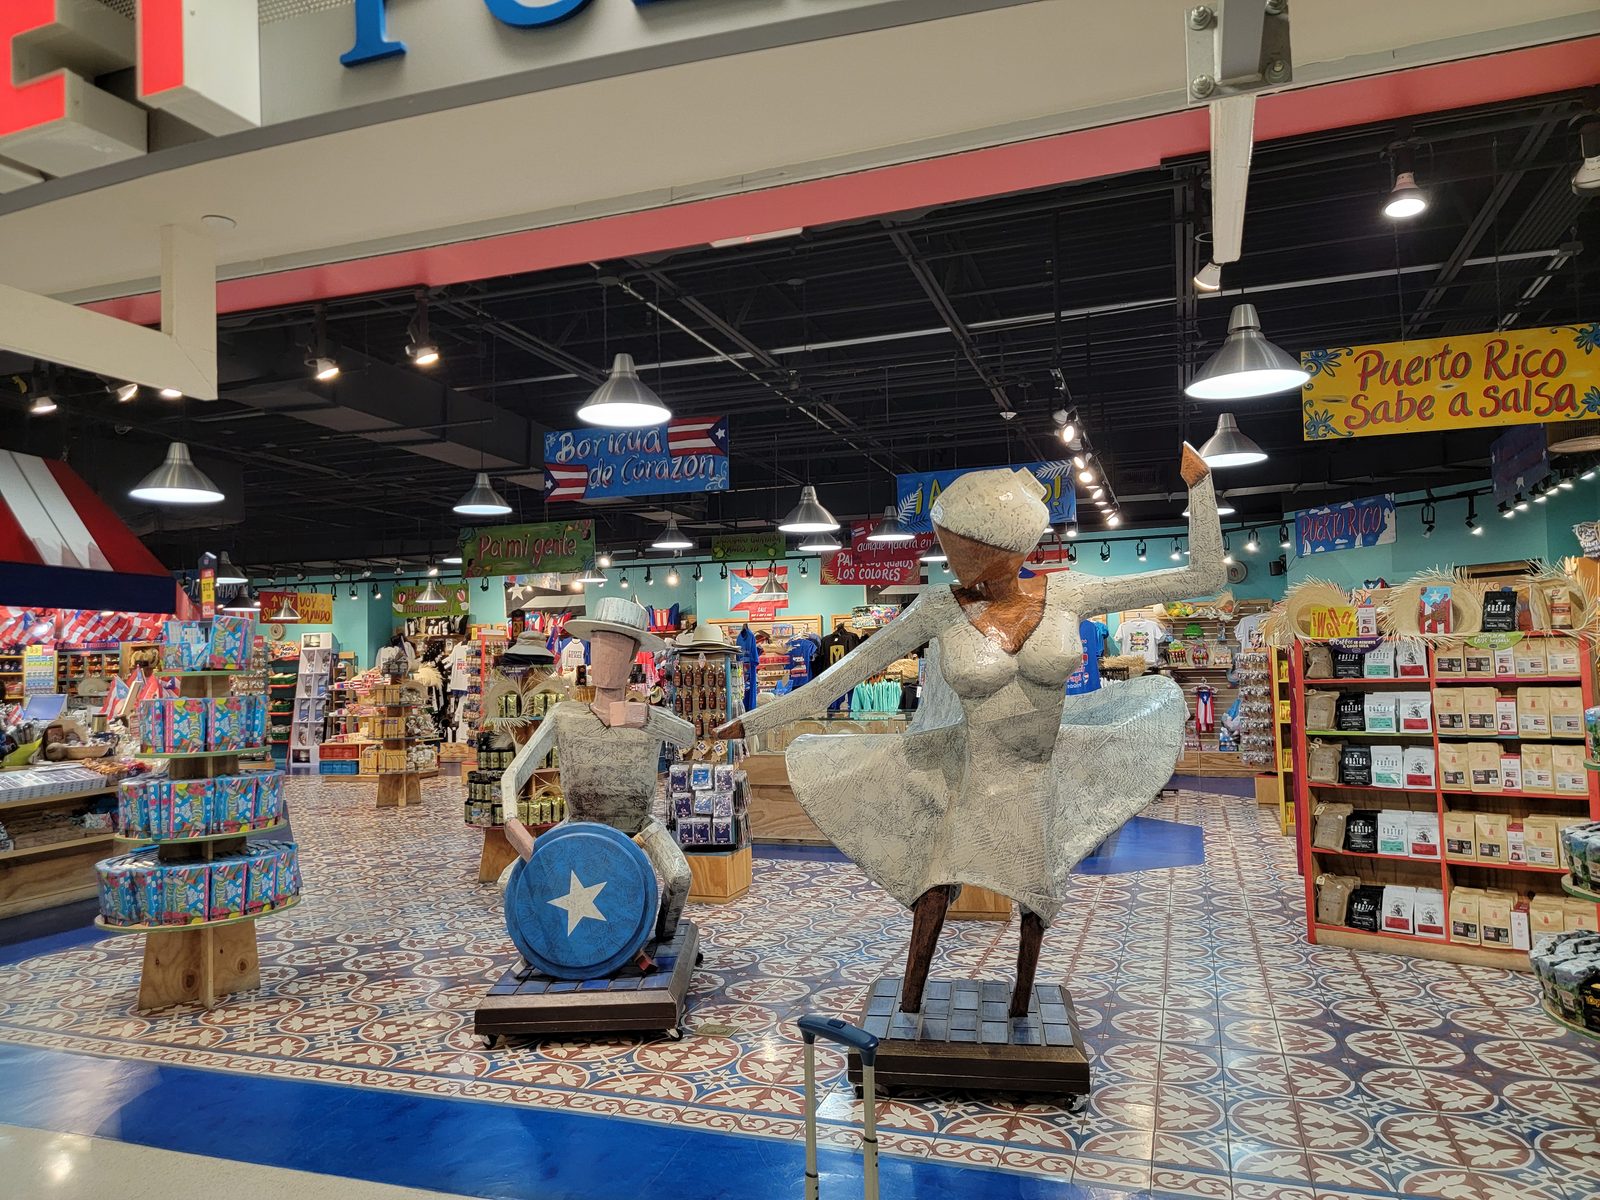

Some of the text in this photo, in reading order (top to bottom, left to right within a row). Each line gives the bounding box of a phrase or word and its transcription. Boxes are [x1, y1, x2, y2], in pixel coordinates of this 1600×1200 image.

[1354, 338, 1567, 391] Puerto Rico
[1344, 390, 1435, 430] Sabe
[1448, 391, 1473, 417] a
[556, 427, 663, 464] Boricua
[588, 459, 616, 489] de
[1301, 504, 1383, 544] PUERTO RICO
[532, 530, 577, 568] gente
[837, 567, 901, 582] LOS COLORES
[300, 596, 317, 608] VOY
